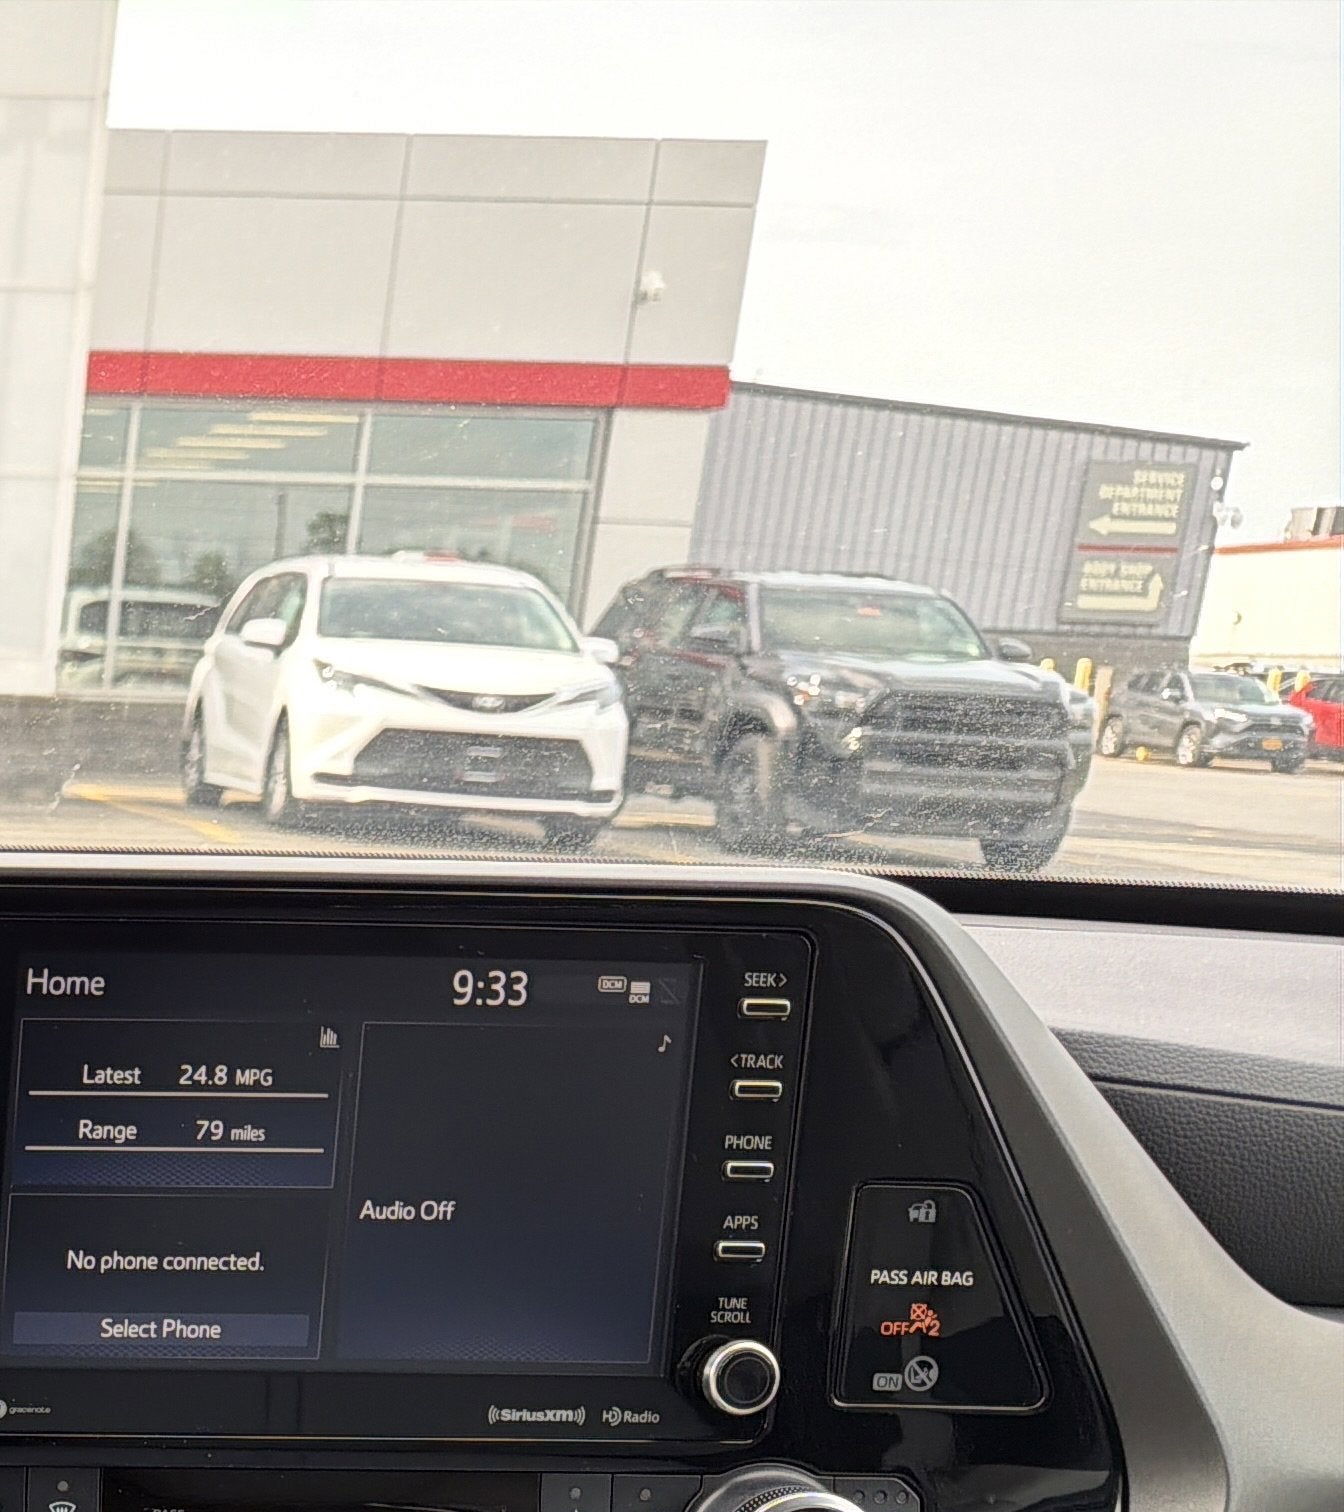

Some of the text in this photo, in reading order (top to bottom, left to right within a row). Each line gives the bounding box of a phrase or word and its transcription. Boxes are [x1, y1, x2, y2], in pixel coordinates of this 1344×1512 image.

[1133, 469, 1185, 485] SERVICE
[1099, 483, 1184, 501] DEPARTMENT
[1112, 501, 1180, 518] ENTRANCE
[1080, 577, 1144, 593] ENTRANCE
[26, 969, 105, 996] Home
[452, 970, 529, 1007] 9:33
[82, 1065, 273, 1086] Latest 24.8 MPG
[78, 1121, 265, 1143] Range 79 miles
[725, 1135, 773, 1151] PHONE
[359, 1200, 456, 1221] Audio Off
[723, 1216, 759, 1231] APPS
[67, 1251, 265, 1274] No phone connected.
[871, 1270, 974, 1287] PASS AIR BAG
[718, 1298, 748, 1311] TUNE
[710, 1311, 751, 1324] SCROLL
[100, 1319, 222, 1339] Select Phone
[880, 1321, 910, 1336] OFF
[876, 1375, 900, 1389] ON
[623, 1410, 660, 1424] Radio
